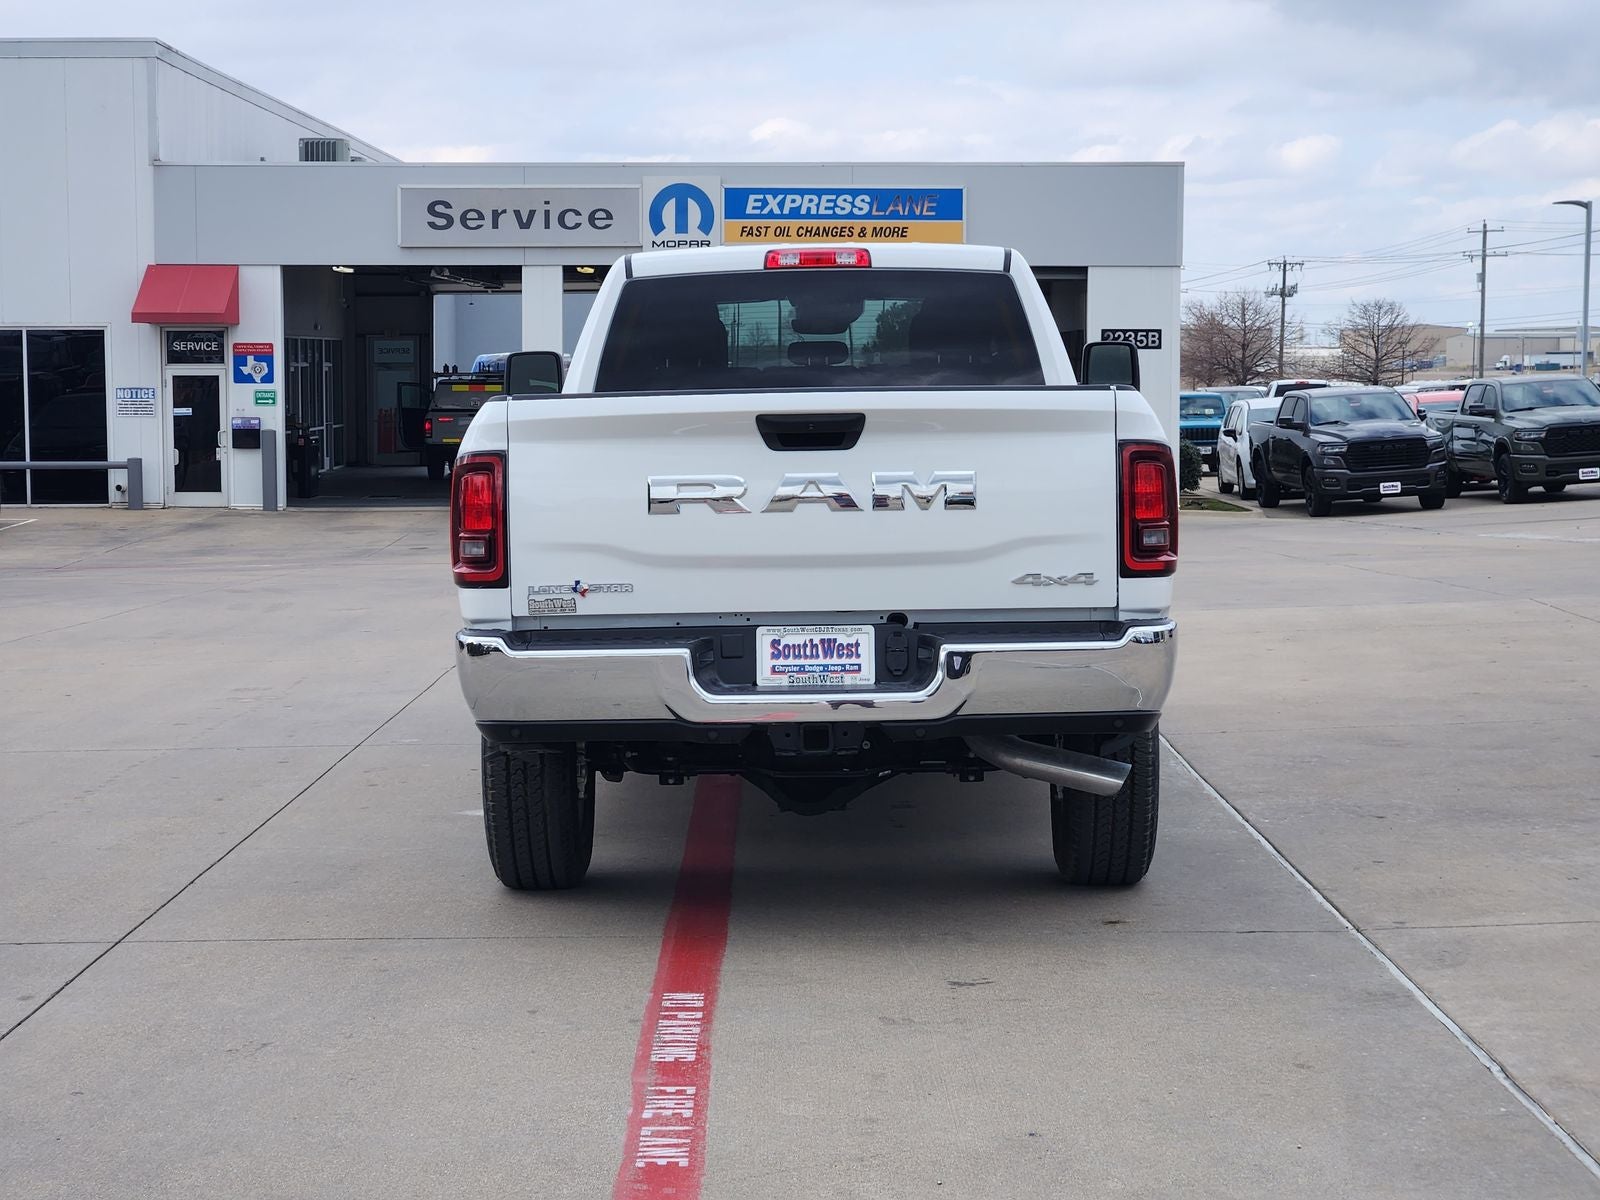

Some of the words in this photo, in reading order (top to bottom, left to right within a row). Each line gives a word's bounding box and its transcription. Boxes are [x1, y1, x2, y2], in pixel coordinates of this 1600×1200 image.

[426, 199, 614, 231] Service
[740, 225, 771, 238] FAST
[773, 225, 792, 238] OIL
[796, 225, 855, 238] CHANGES
[858, 226, 868, 238] &
[871, 226, 909, 238] MORE
[652, 240, 711, 248] MOPAR
[172, 341, 219, 351] SERVICE
[116, 388, 155, 399] NOTICE
[647, 470, 977, 515] RAM
[528, 585, 572, 595] LONE
[588, 583, 633, 593] STAR
[528, 598, 576, 609] SouthWest
[770, 638, 861, 660] SouthWest
[804, 664, 823, 672] Dodge
[828, 664, 842, 672] Jeep
[788, 674, 845, 684] SouthWest
[651, 1011, 703, 1062] PARKING
[642, 1086, 697, 1119] FIRE
[635, 1126, 694, 1167] LANE
